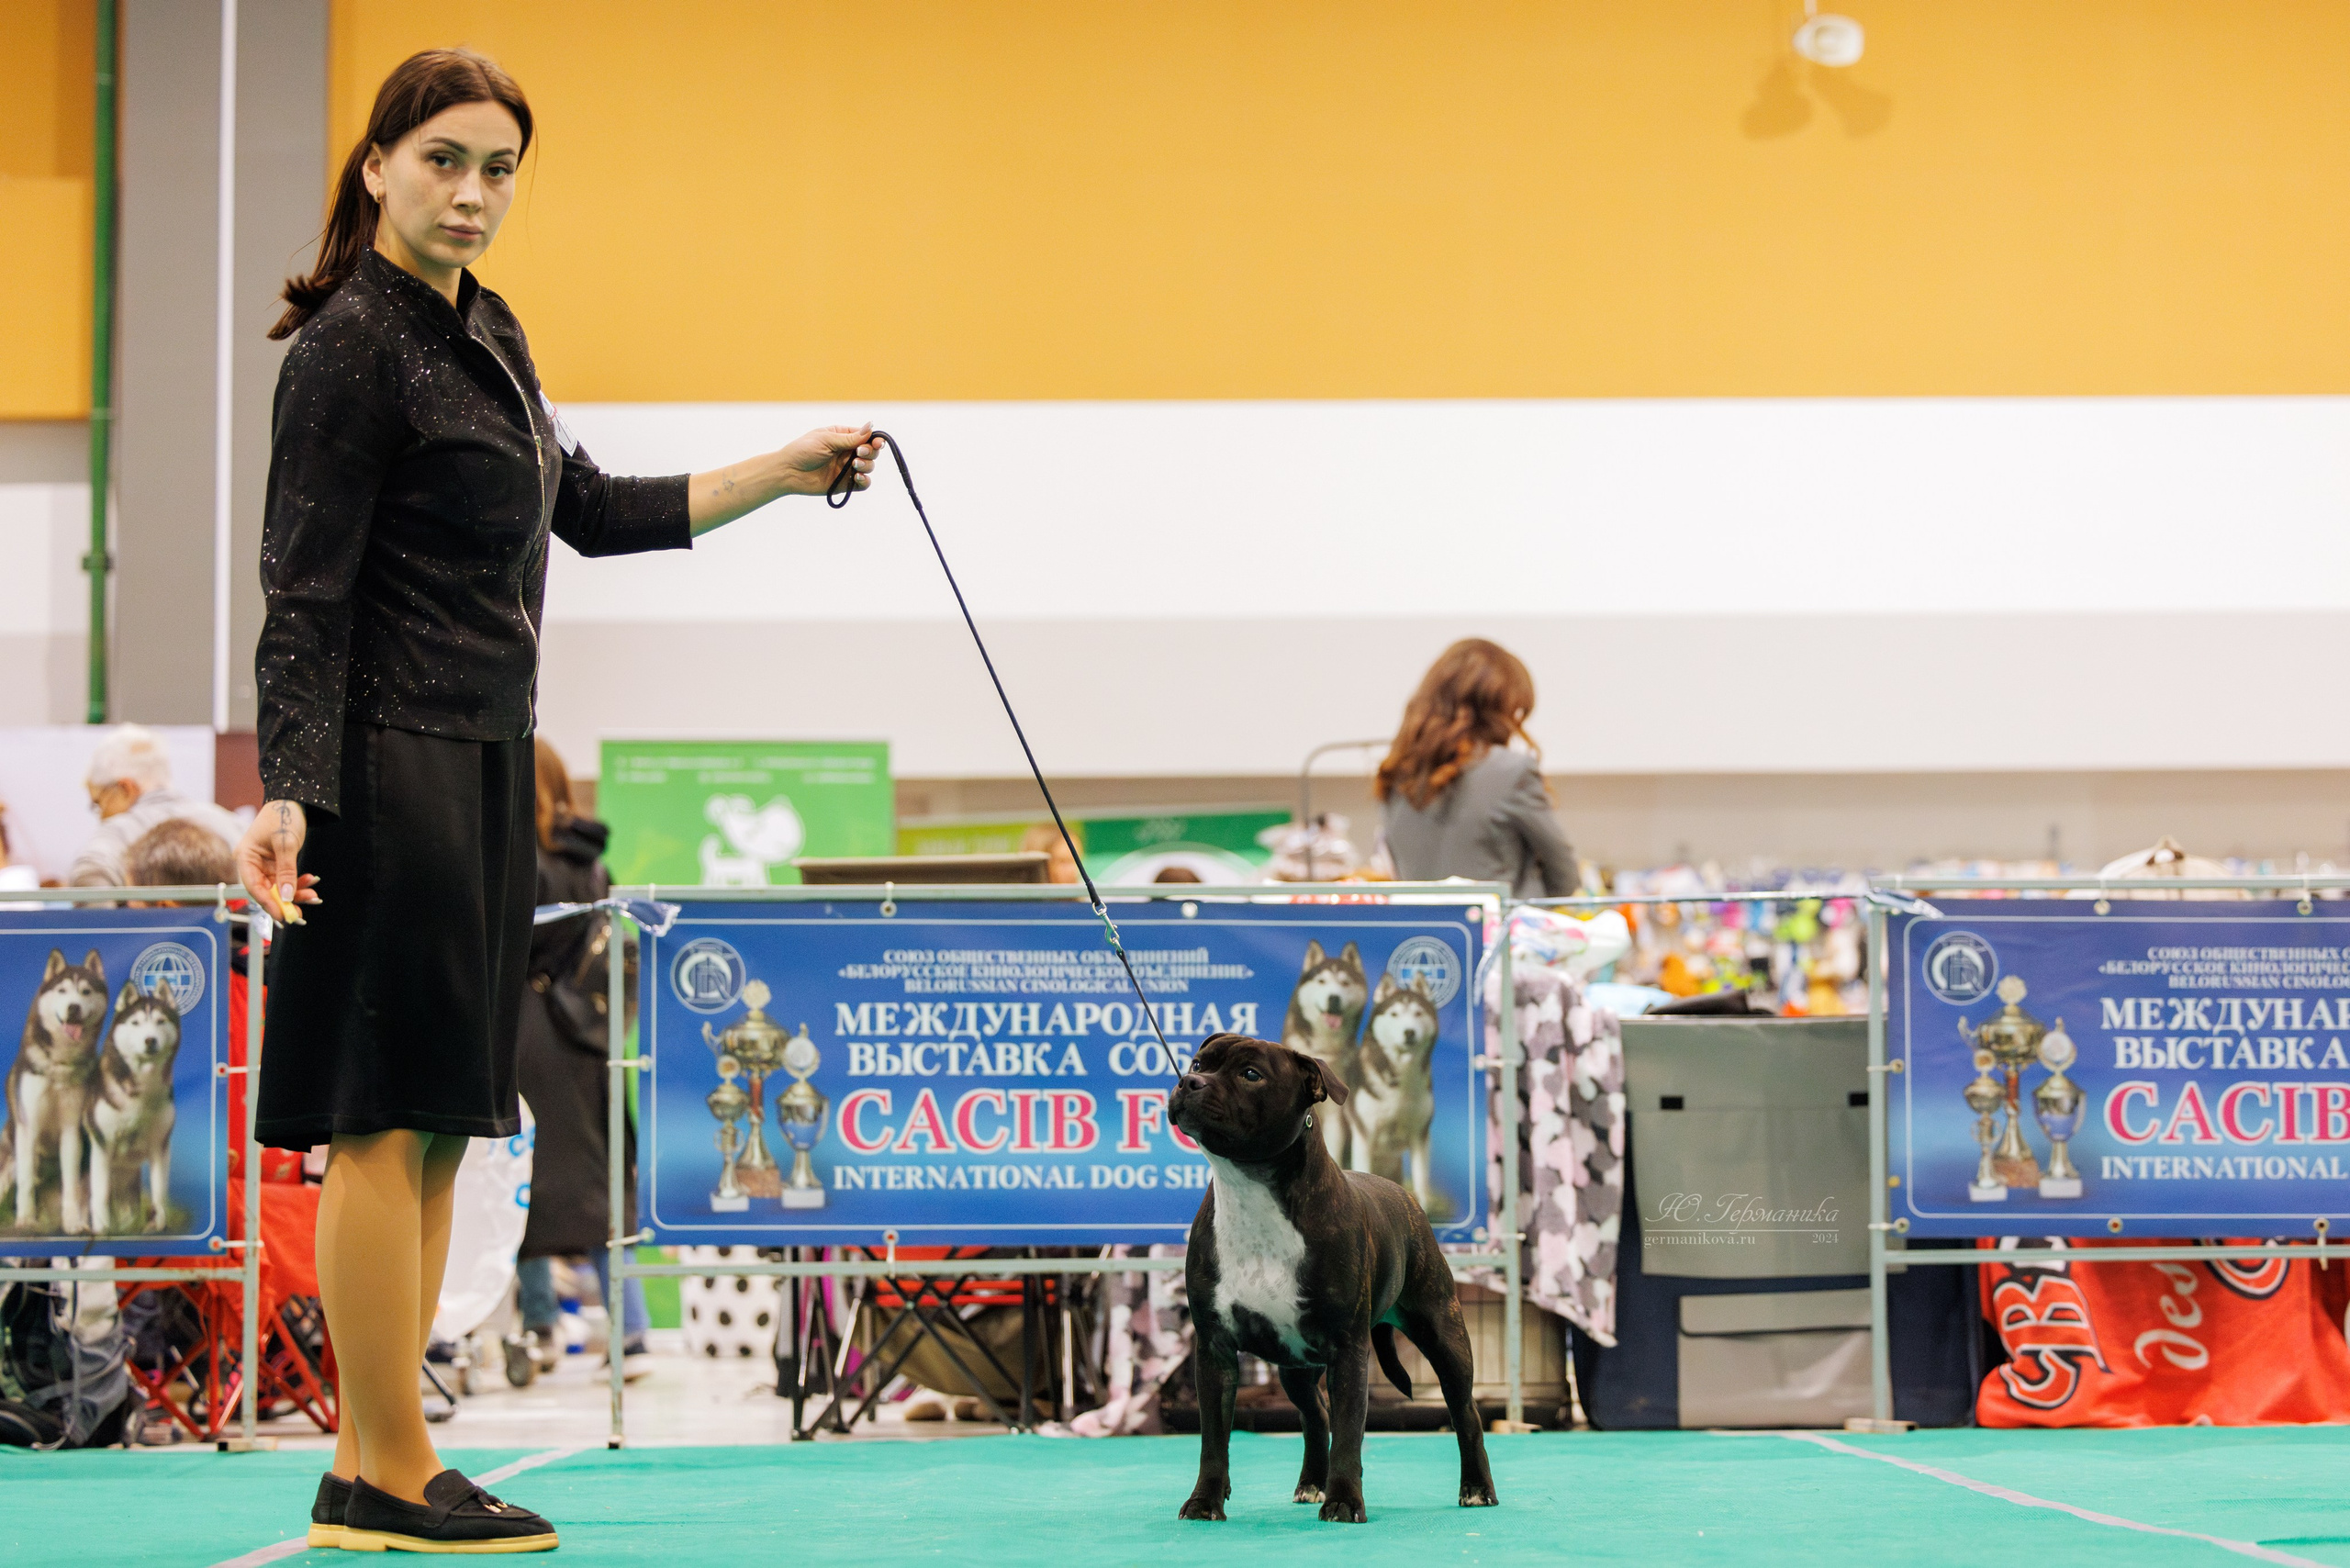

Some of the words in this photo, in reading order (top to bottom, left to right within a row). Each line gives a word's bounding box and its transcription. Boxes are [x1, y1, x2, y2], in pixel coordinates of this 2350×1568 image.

[834, 1002, 1259, 1042] МЕЖДУНАРОДНАЯ
[846, 1042, 1088, 1076] ВЫСТАВКА
[2113, 1036, 2350, 1070] ВЫСТАВКА
[836, 1087, 1101, 1155] CACIB
[2102, 1081, 2350, 1146] CACIB
[834, 1164, 1084, 1190] INTERNATIONAL
[1090, 1164, 1158, 1190] DOG
[2100, 1156, 2348, 1180] INTERNATIONAL
